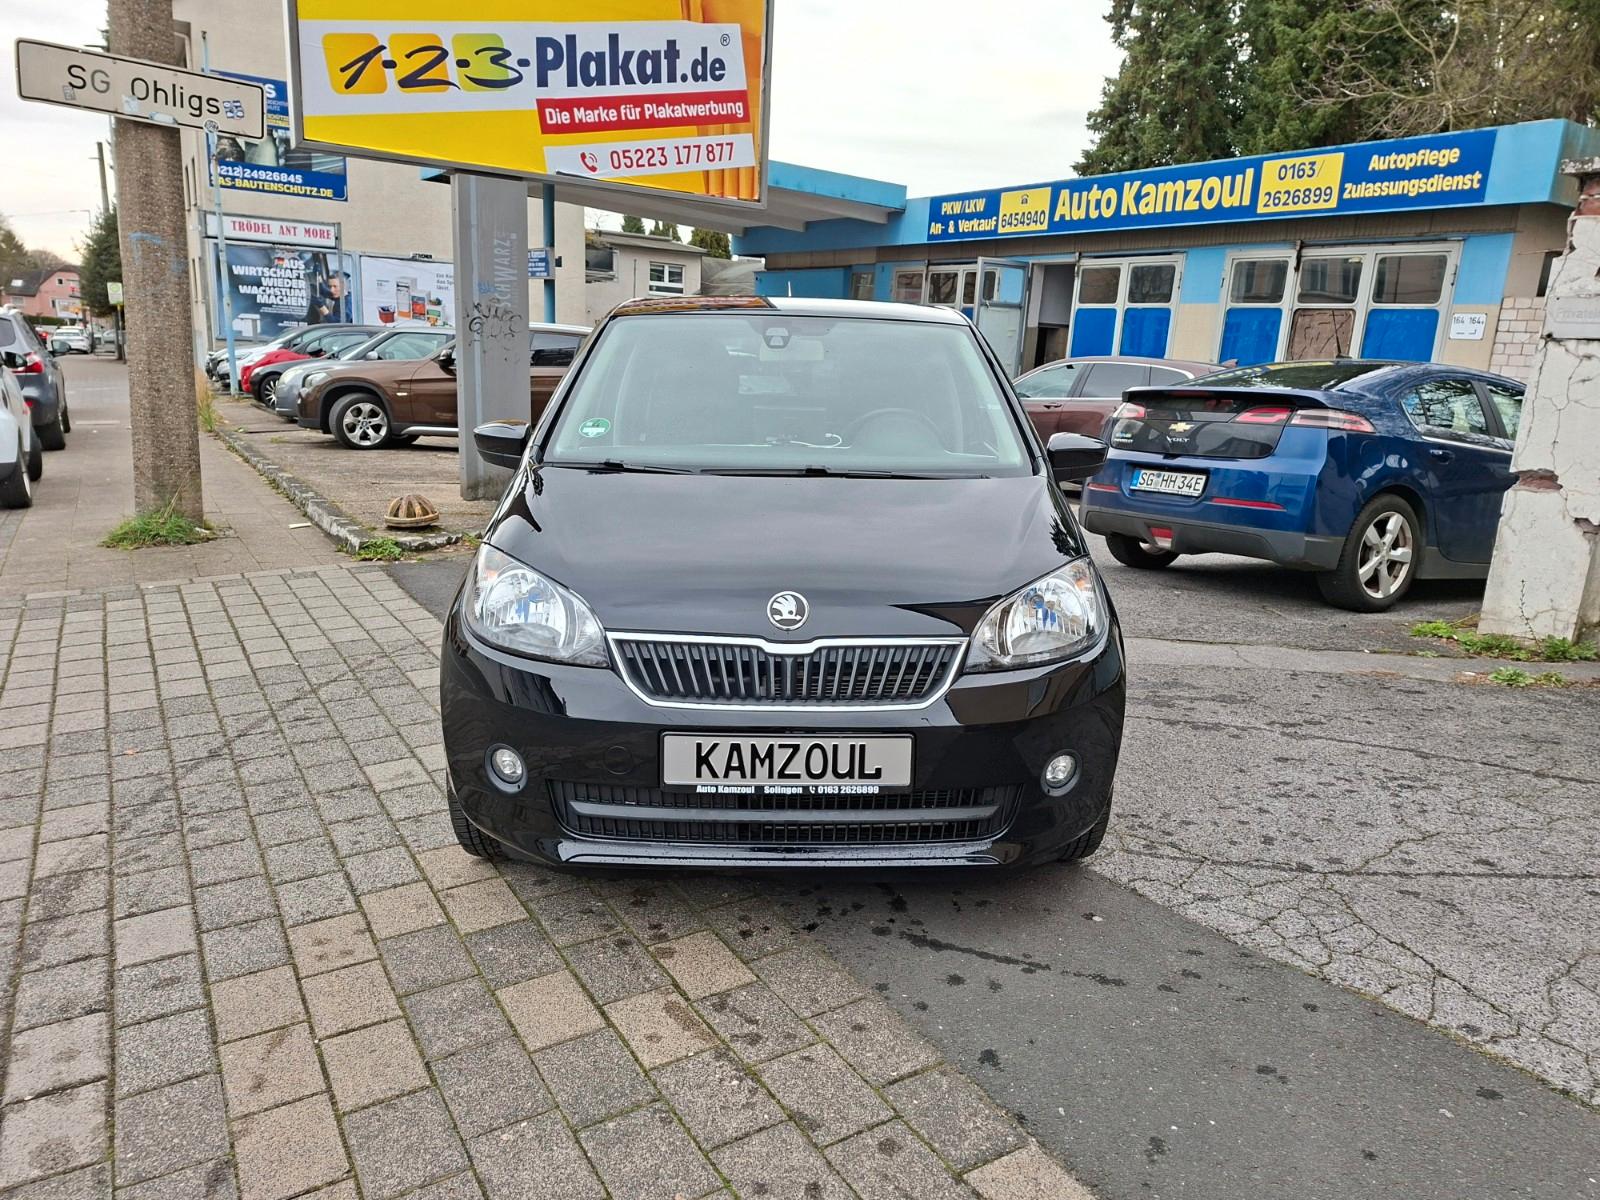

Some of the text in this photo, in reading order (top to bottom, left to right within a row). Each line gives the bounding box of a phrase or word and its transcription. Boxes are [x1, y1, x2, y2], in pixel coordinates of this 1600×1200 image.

[67, 64, 110, 94] SG
[130, 77, 220, 118] Ohligs
[545, 101, 744, 125] Die Marke für Plakatwerbung
[610, 142, 735, 170] 05223 177 877
[1368, 147, 1460, 171] Autopflege
[1343, 170, 1483, 199] Zulassungsdienst
[1053, 169, 1254, 222] Auto Kamzoul
[1263, 186, 1333, 208] 2626899
[941, 198, 986, 215] PKW/LKW
[930, 215, 998, 235] An- & Verkauf
[1001, 209, 1046, 229] 6454940
[231, 220, 332, 240] TRÖDEL ANT MORE
[232, 265, 305, 279] WIRTSCHAFT
[283, 260, 305, 270] AUS
[239, 285, 306, 298] WACHSTUM
[261, 277, 306, 289] WIEDER
[256, 295, 307, 306] MACHEN
[1139, 472, 1203, 491] SG HH 34E
[695, 741, 882, 780] KAMZOUL
[696, 785, 717, 793] Auto
[718, 785, 755, 794] Kamzoul
[764, 785, 803, 794] Solingen
[818, 785, 839, 794] 0163
